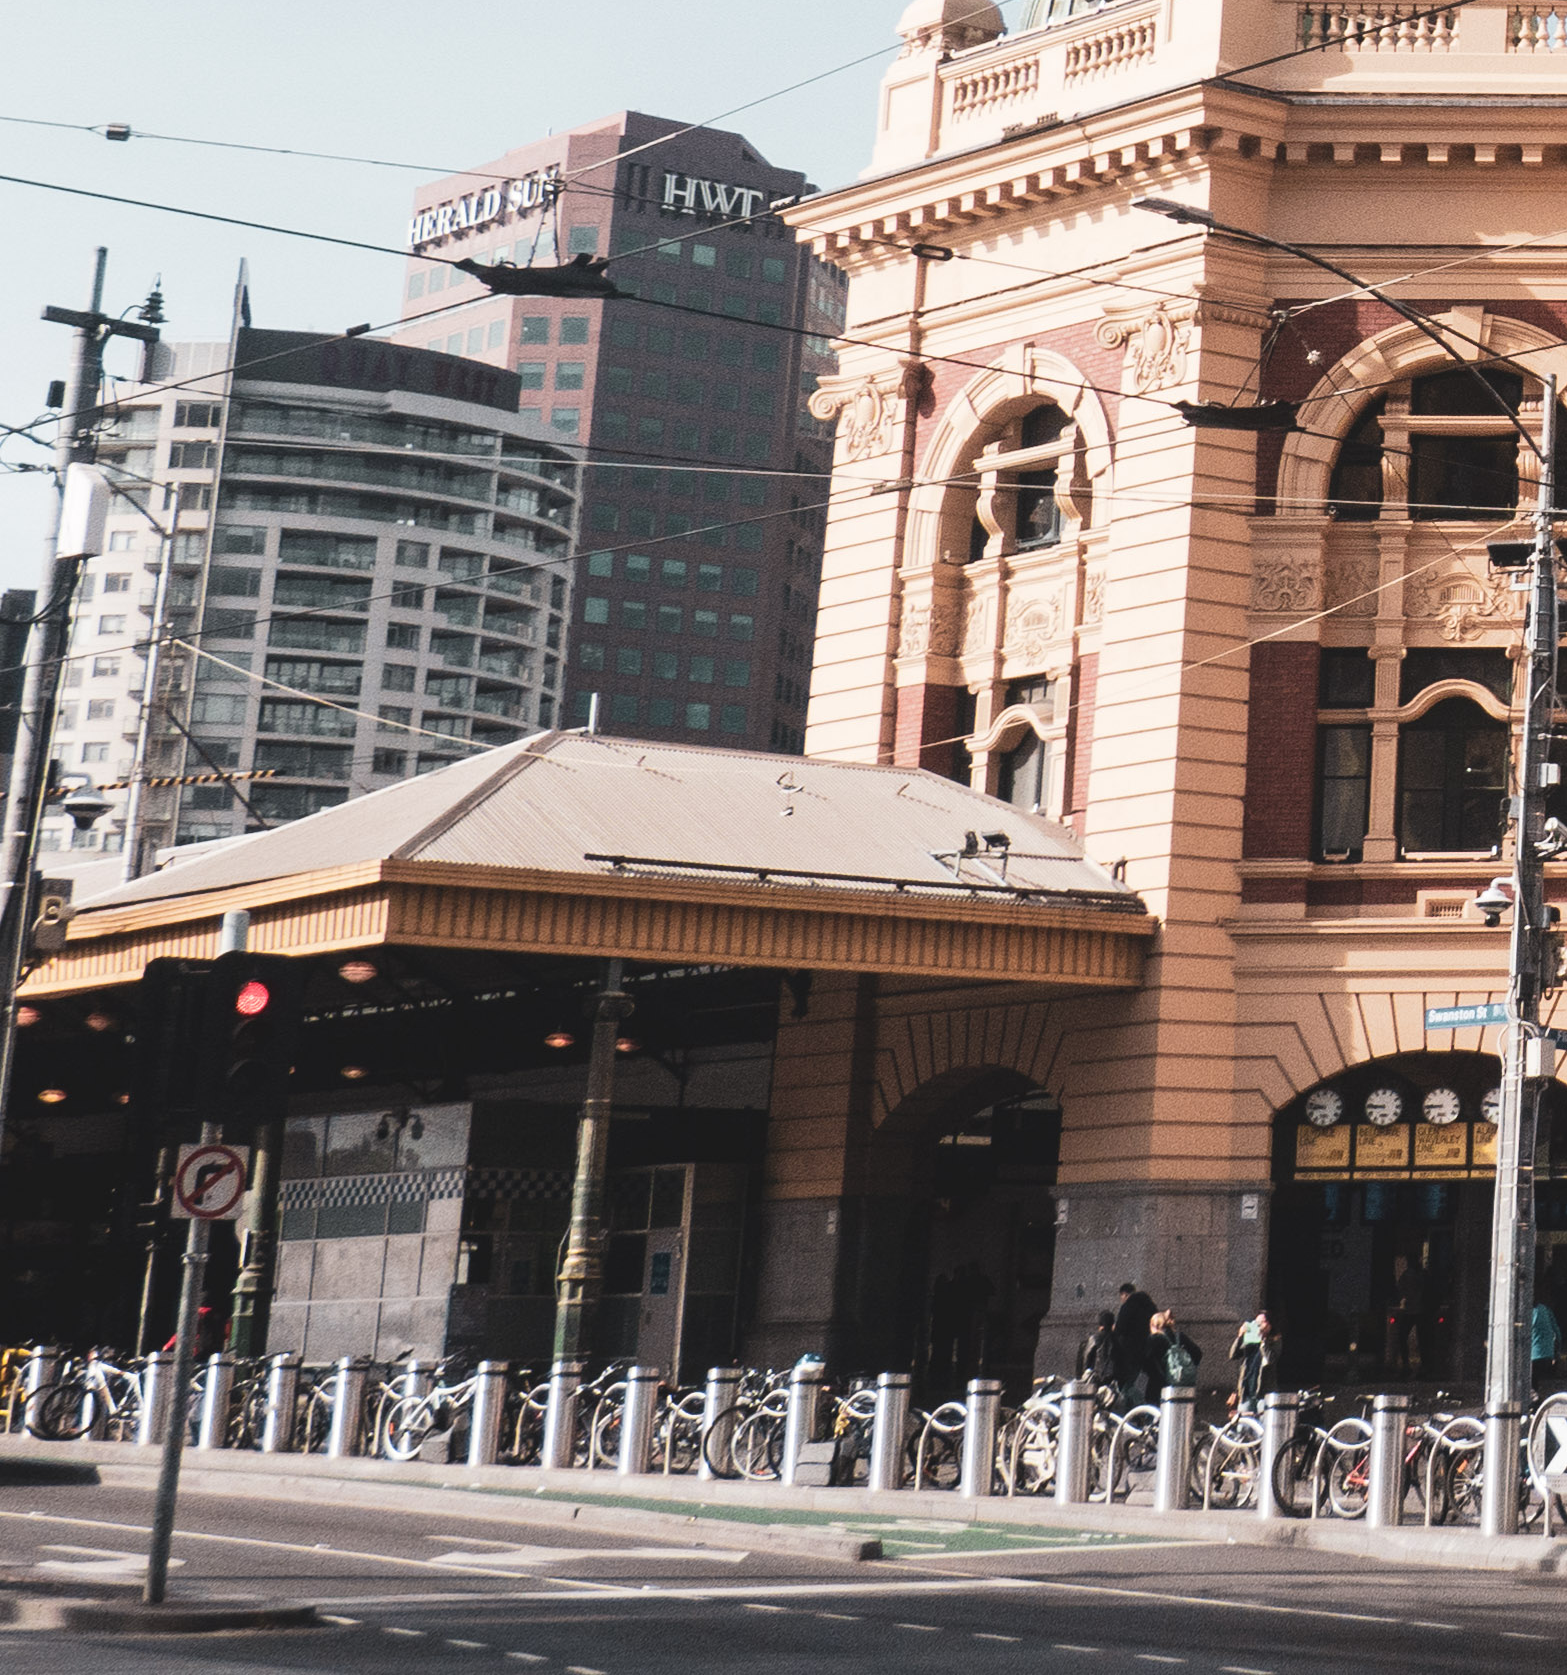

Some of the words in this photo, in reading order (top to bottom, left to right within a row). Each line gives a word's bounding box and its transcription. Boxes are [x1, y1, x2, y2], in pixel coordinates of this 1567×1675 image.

[407, 190, 502, 246] HERALD
[506, 169, 559, 213] SUN
[664, 174, 763, 218] HWT
[1428, 1009, 1475, 1023] Swanston
[1476, 1005, 1488, 1019] St
